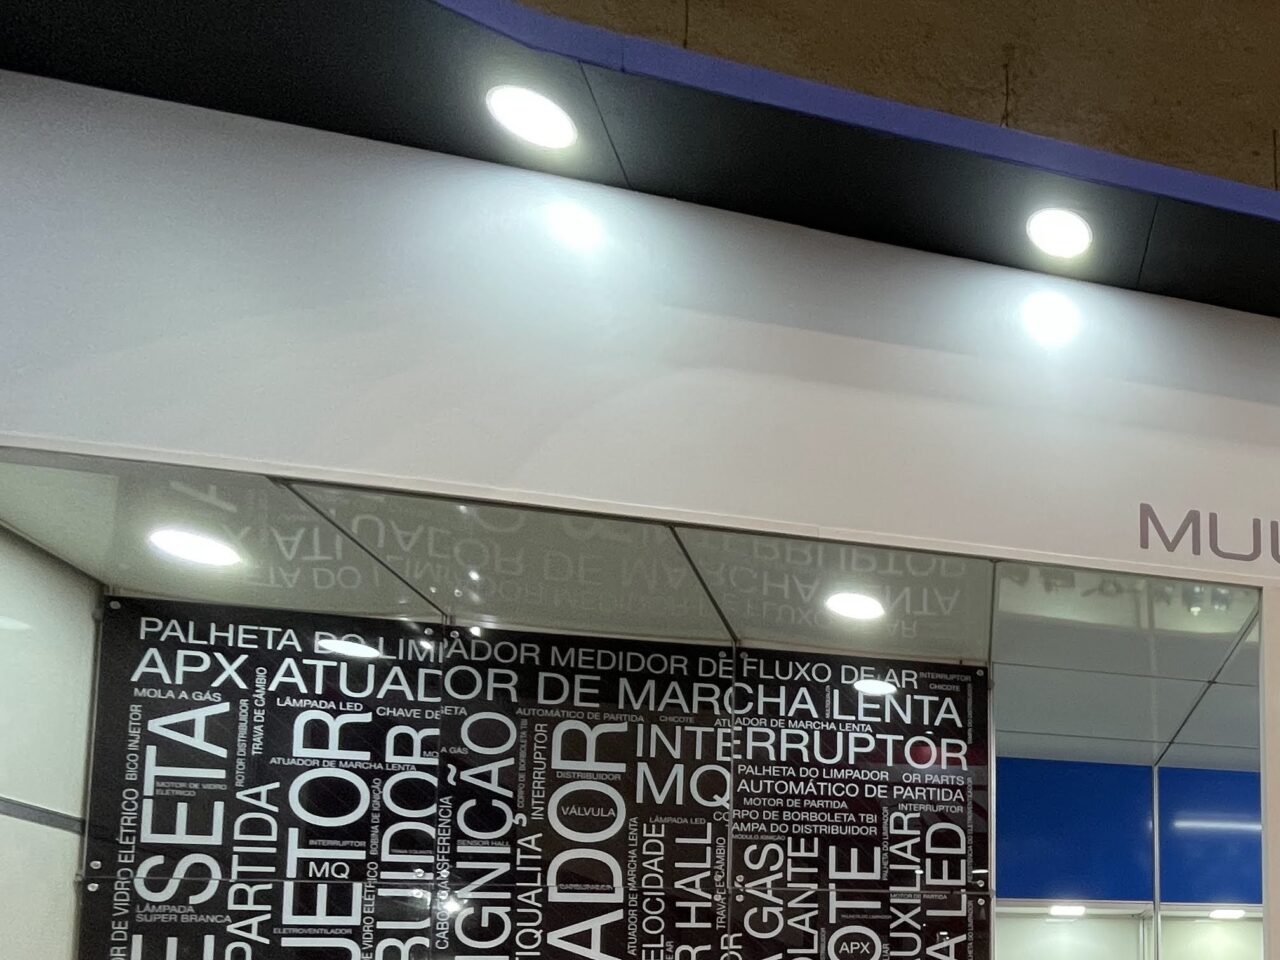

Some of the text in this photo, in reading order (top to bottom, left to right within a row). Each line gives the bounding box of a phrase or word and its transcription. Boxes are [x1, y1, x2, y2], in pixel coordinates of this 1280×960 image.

[140, 617, 918, 689] PALHETA LIMPADOR MEDIDOR DE FLUXO DE AR
[920, 672, 971, 682] INTERRUPTOR
[130, 648, 249, 689] APX
[268, 657, 518, 701] ATUADOR
[538, 671, 600, 707] DE
[618, 677, 817, 718] MARCHA
[833, 689, 962, 728] LENTA
[134, 688, 221, 702] MOLA A GÁS
[929, 683, 960, 692] CHICOTE
[277, 698, 363, 711] LÂMPADA LED
[376, 707, 421, 718] CHAVE
[516, 707, 644, 723] AUTOMÁTICO DE PARTIDA
[659, 715, 694, 723] CHICOTE
[771, 719, 872, 732] DE MARCHA LENTA
[125, 704, 142, 780] BICO INJETOR
[235, 699, 249, 787] ROTOR DISTRIBUIDOR
[252, 723, 263, 755] TRAVA
[636, 723, 968, 771] INTERRUPTOR
[270, 757, 416, 771] ATUADOR MARCHA LENTA
[530, 723, 548, 820] INTERRUPTOR
[556, 771, 621, 781] DISTRIBUIDOR
[738, 765, 964, 785] PALHETA DO LIMPADOR OR PARTS
[636, 761, 730, 807] MQ
[737, 778, 964, 801] AUTOMÁTICO DE PARTIDA
[133, 702, 230, 905] SETA
[561, 805, 616, 818] VÁLVULA
[744, 798, 847, 809] MOTOR DE PARTIDA
[899, 803, 963, 813] INTERRUPTOR
[116, 788, 138, 863] ELÉTRICO
[650, 816, 688, 824] LÂMPADA
[763, 811, 877, 823] DE BORBOLETA TBI
[771, 824, 877, 835] DO DISTRIBUIDOR
[309, 839, 366, 848] INTERRUPTOR
[370, 825, 379, 855] BOBINA
[309, 862, 350, 879] MQ
[674, 822, 712, 928] HALL
[926, 822, 967, 917] LED
[114, 869, 133, 916] VIDRO
[628, 817, 638, 956] ATUADOR MARCHA LENTA
[743, 841, 785, 939] GÁS
[136, 904, 195, 913] LÂMPADA
[136, 914, 232, 924] SUPER BRANCA
[110, 920, 128, 941] DE
[362, 916, 374, 950] VIDRO
[839, 942, 870, 953] APX
